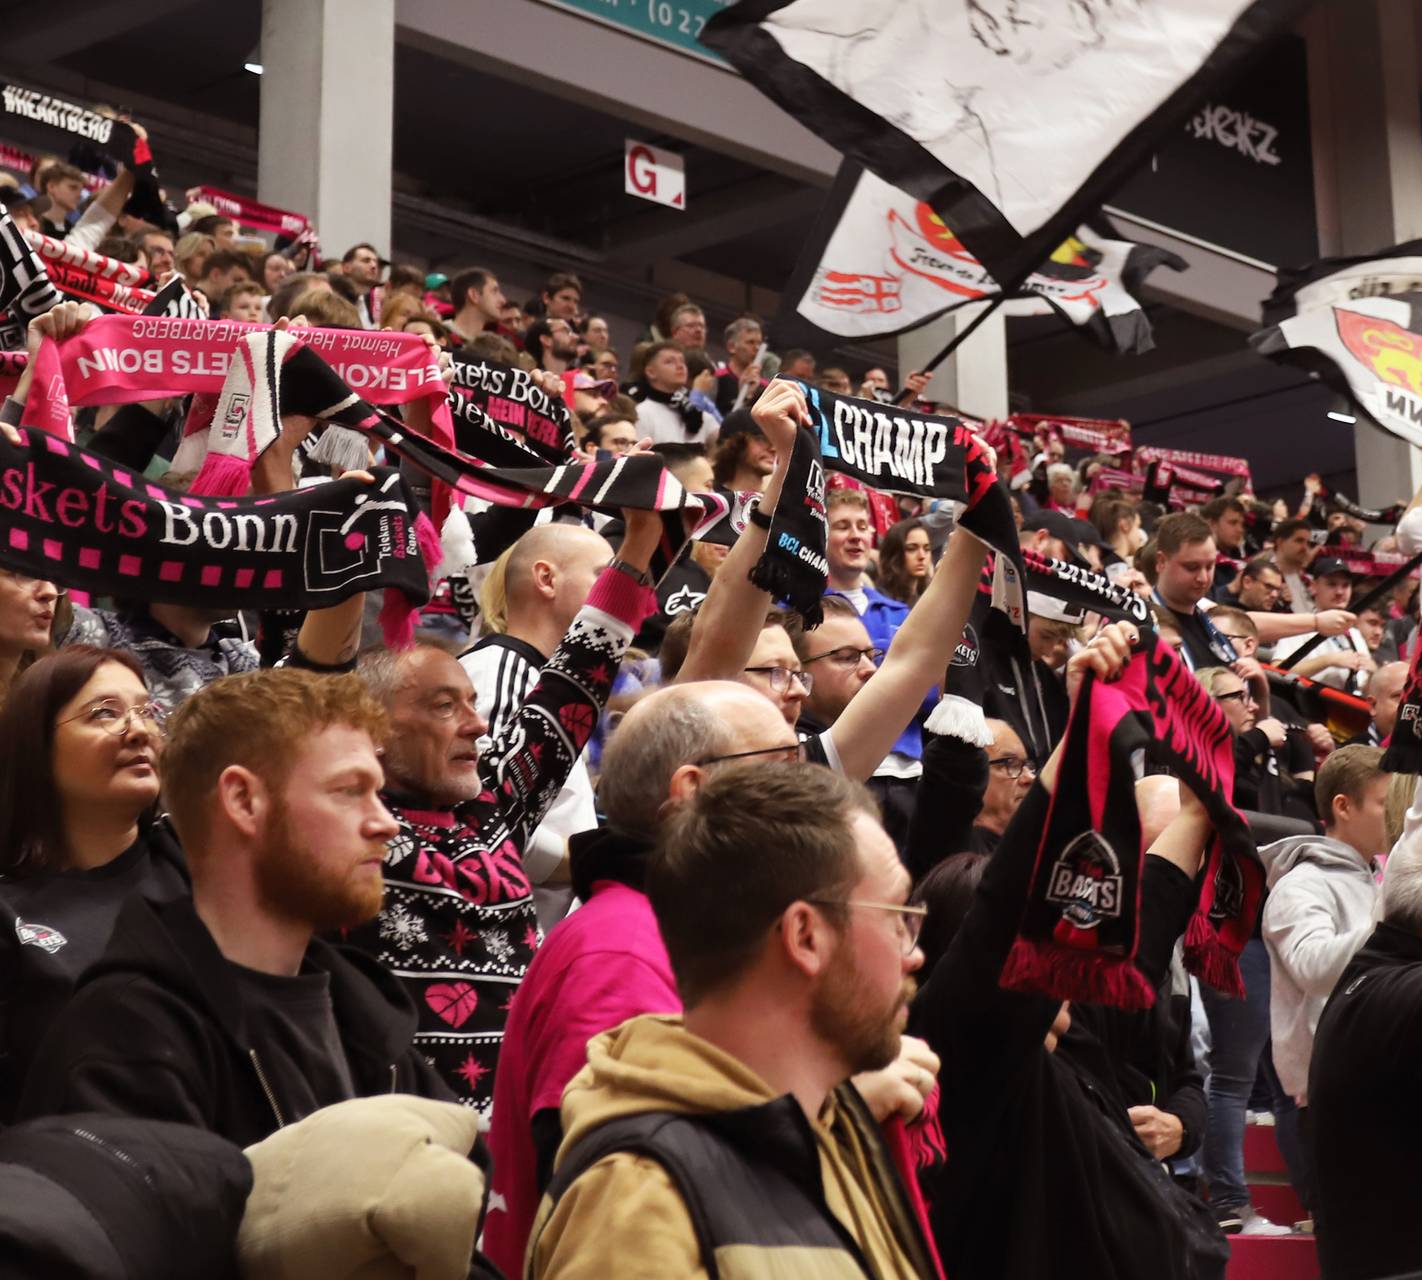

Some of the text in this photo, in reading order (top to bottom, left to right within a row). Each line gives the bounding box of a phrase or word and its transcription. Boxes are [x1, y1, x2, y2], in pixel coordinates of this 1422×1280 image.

[2, 85, 113, 143] #HEARTBERG
[627, 144, 658, 197] G
[342, 335, 402, 359] Heimat.
[333, 361, 443, 392] ELEKO
[834, 399, 948, 488] CHAMP
[1, 461, 298, 554] skets Bonn
[378, 515, 392, 560] Telekom
[778, 532, 830, 577] BCL CHAM
